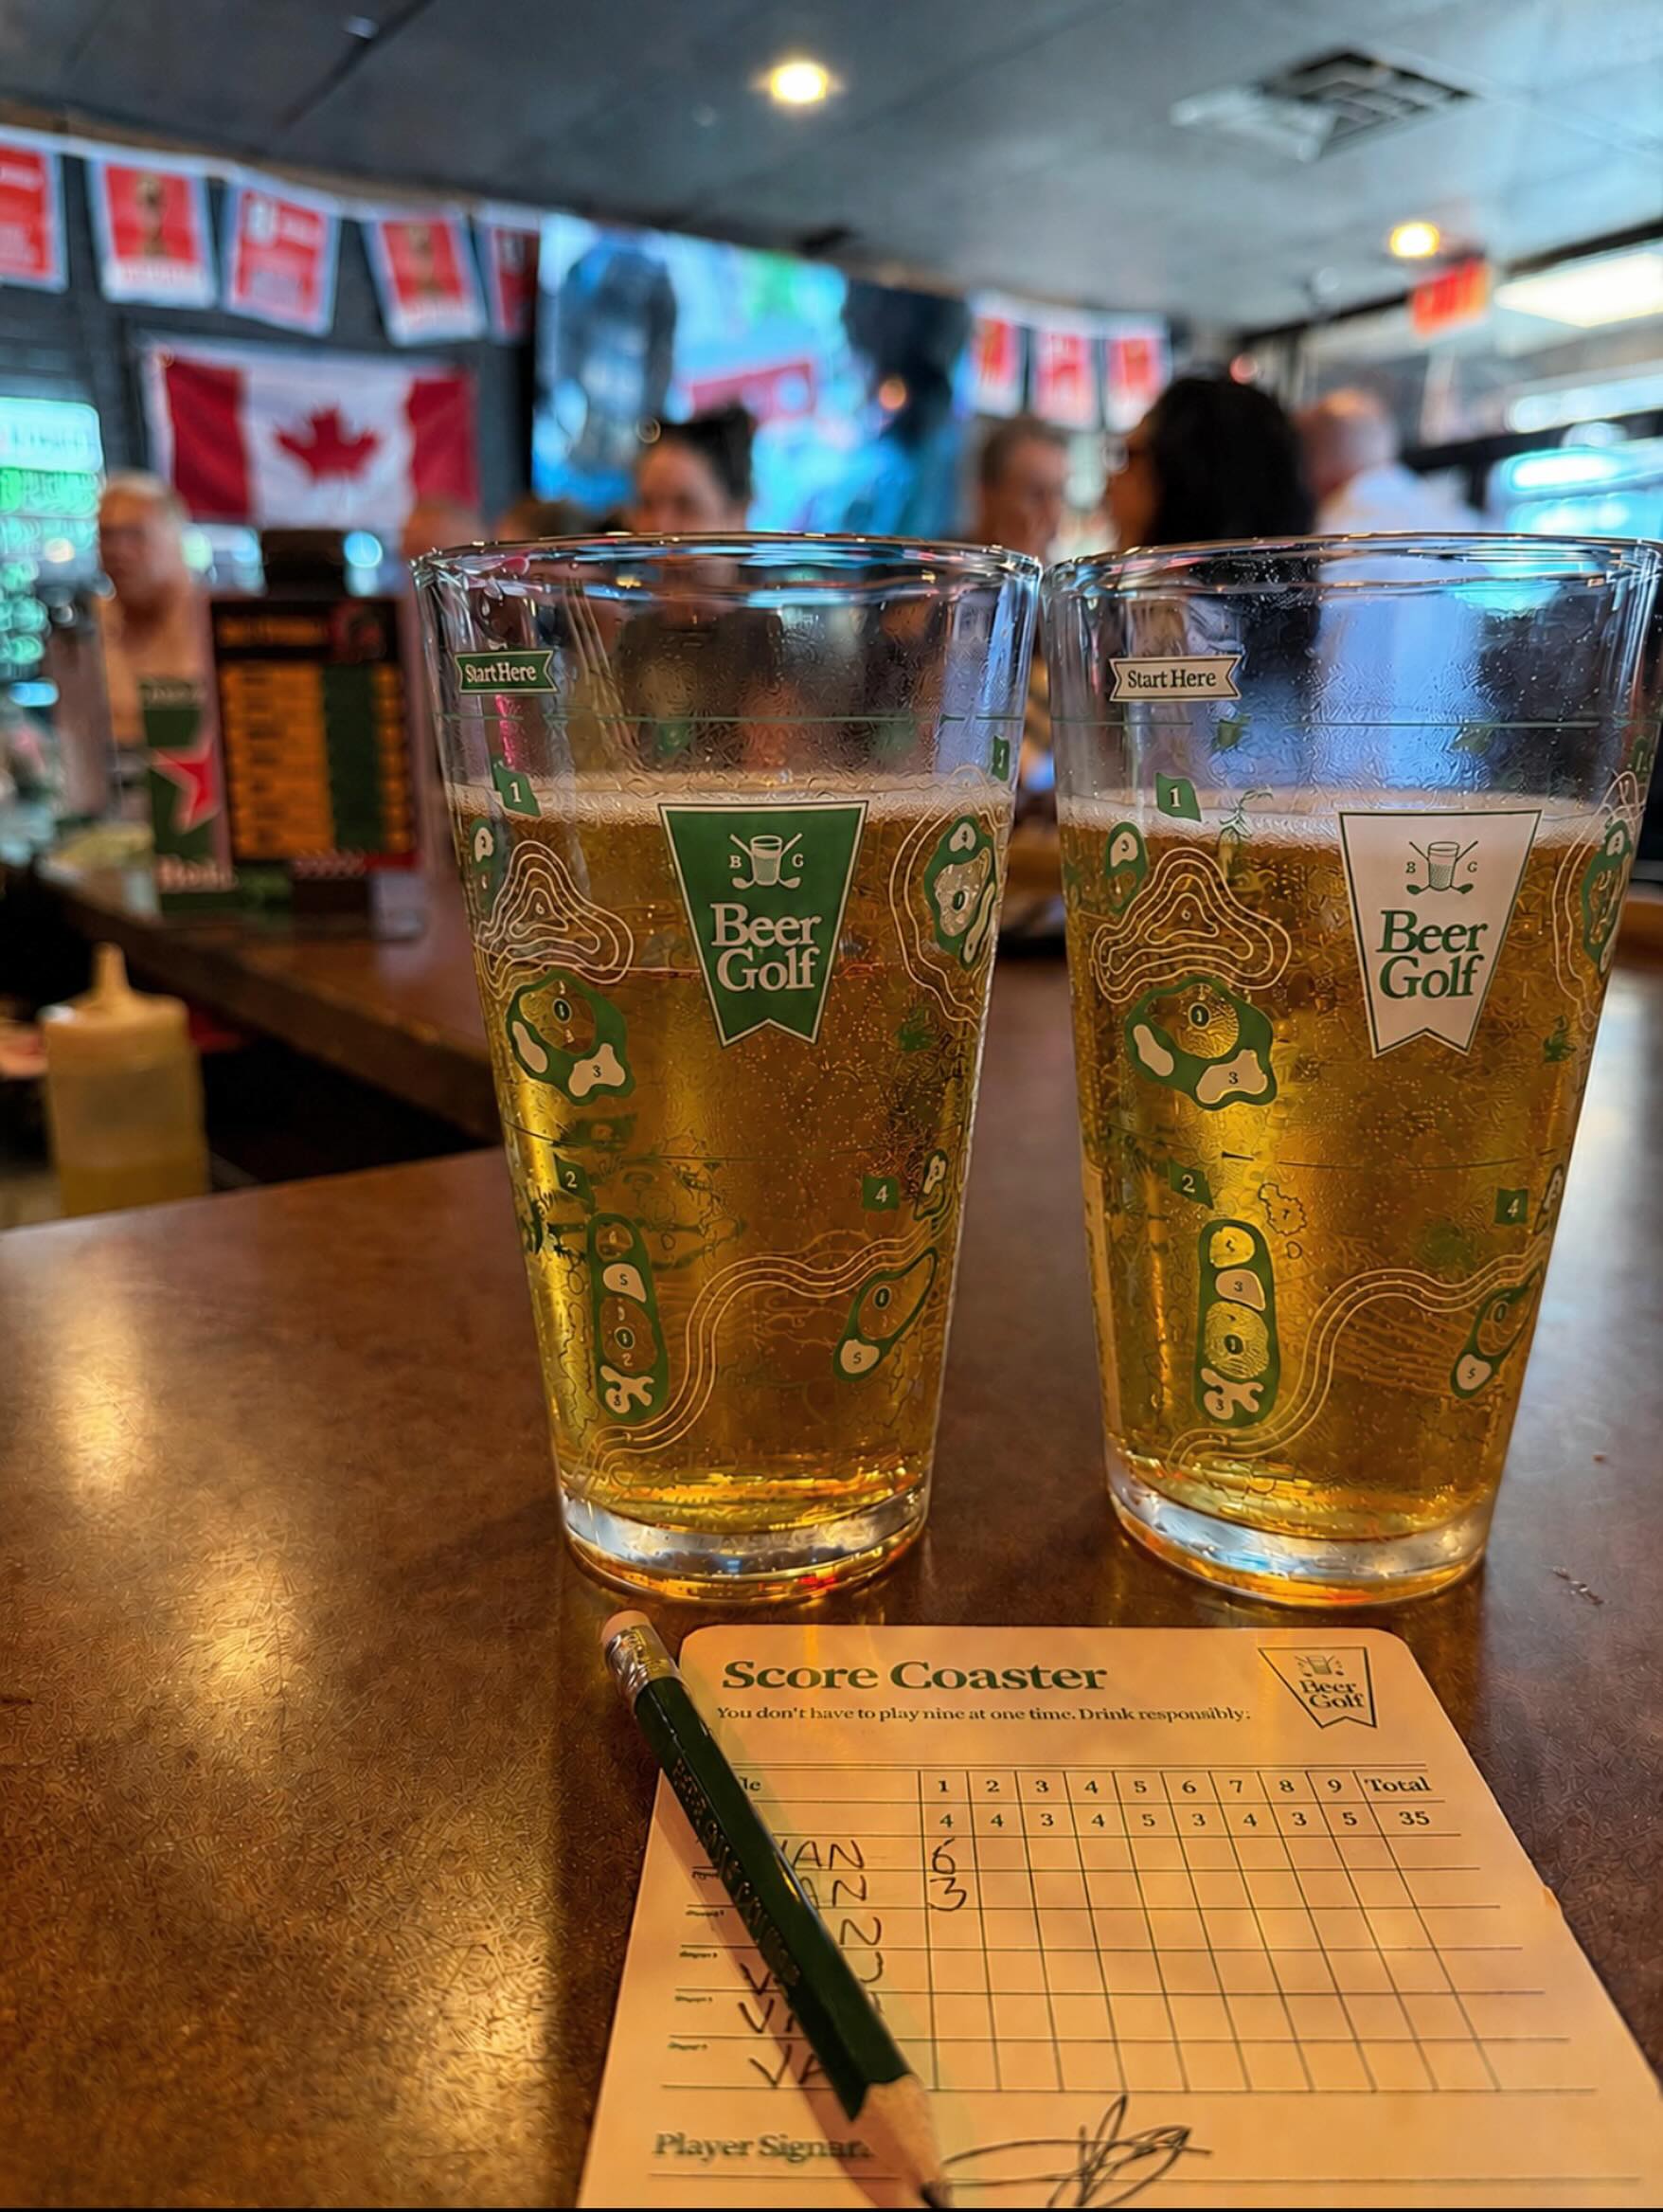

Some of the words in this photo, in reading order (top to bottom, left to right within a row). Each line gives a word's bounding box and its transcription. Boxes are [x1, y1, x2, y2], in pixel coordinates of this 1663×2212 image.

[465, 663, 498, 683] Start
[497, 662, 537, 682] Here
[1127, 670, 1168, 689] Start
[1170, 669, 1217, 688] Here
[510, 782, 522, 803] 1
[1170, 785, 1181, 808] 1
[729, 855, 742, 869] B
[792, 854, 804, 868] G
[1467, 861, 1478, 873] G
[710, 903, 822, 947] Beer
[1376, 909, 1488, 955] Beer
[717, 946, 821, 992] Golf
[1379, 954, 1485, 999] Golf
[592, 1065, 601, 1078] 3
[1228, 1071, 1239, 1085] 3
[565, 1170, 578, 1188] 2
[1182, 1175, 1195, 1193] 2
[875, 1184, 888, 1203] 4
[1507, 1198, 1519, 1218] 4
[1234, 1280, 1243, 1292] 3
[852, 1351, 862, 1364] 5
[1466, 1367, 1476, 1379] 5
[722, 1660, 880, 1690] Score
[889, 1660, 1108, 1690] Coaster
[1298, 1679, 1356, 1694] Beer
[1309, 1693, 1365, 1709] Golf
[717, 1707, 752, 1719] You
[755, 1706, 806, 1719] don't
[810, 1707, 853, 1719] have
[857, 1708, 876, 1719] to
[879, 1707, 920, 1723] play
[922, 1707, 965, 1719] nine
[968, 1709, 986, 1720] at
[990, 1709, 1025, 1720] one
[1028, 1707, 1076, 1720] time.
[1079, 1707, 1135, 1720] Drink
[938, 1780, 950, 1793] 1
[985, 1779, 1000, 1793] 2
[1035, 1779, 1049, 1793] 3
[1084, 1780, 1099, 1794] 4
[1134, 1780, 1147, 1793] 5
[1182, 1779, 1197, 1794] 6
[1229, 1779, 1243, 1793] 7
[1279, 1779, 1295, 1793] 8
[1328, 1778, 1342, 1793] 9
[1364, 1776, 1432, 1793] Total
[939, 1813, 954, 1827] 4
[991, 1813, 1004, 1827] 4
[1040, 1813, 1054, 1826] 3
[1091, 1813, 1105, 1827] 4
[1142, 1813, 1155, 1826] 5
[1191, 1813, 1206, 1827] 3
[1243, 1813, 1258, 1827] 4
[1292, 1811, 1307, 1826] 3
[1343, 1811, 1357, 1826] 5
[1398, 1810, 1430, 1826] 35
[932, 1837, 956, 1875] 6
[927, 1877, 967, 1912] 3
[653, 2132, 754, 2163] Player
